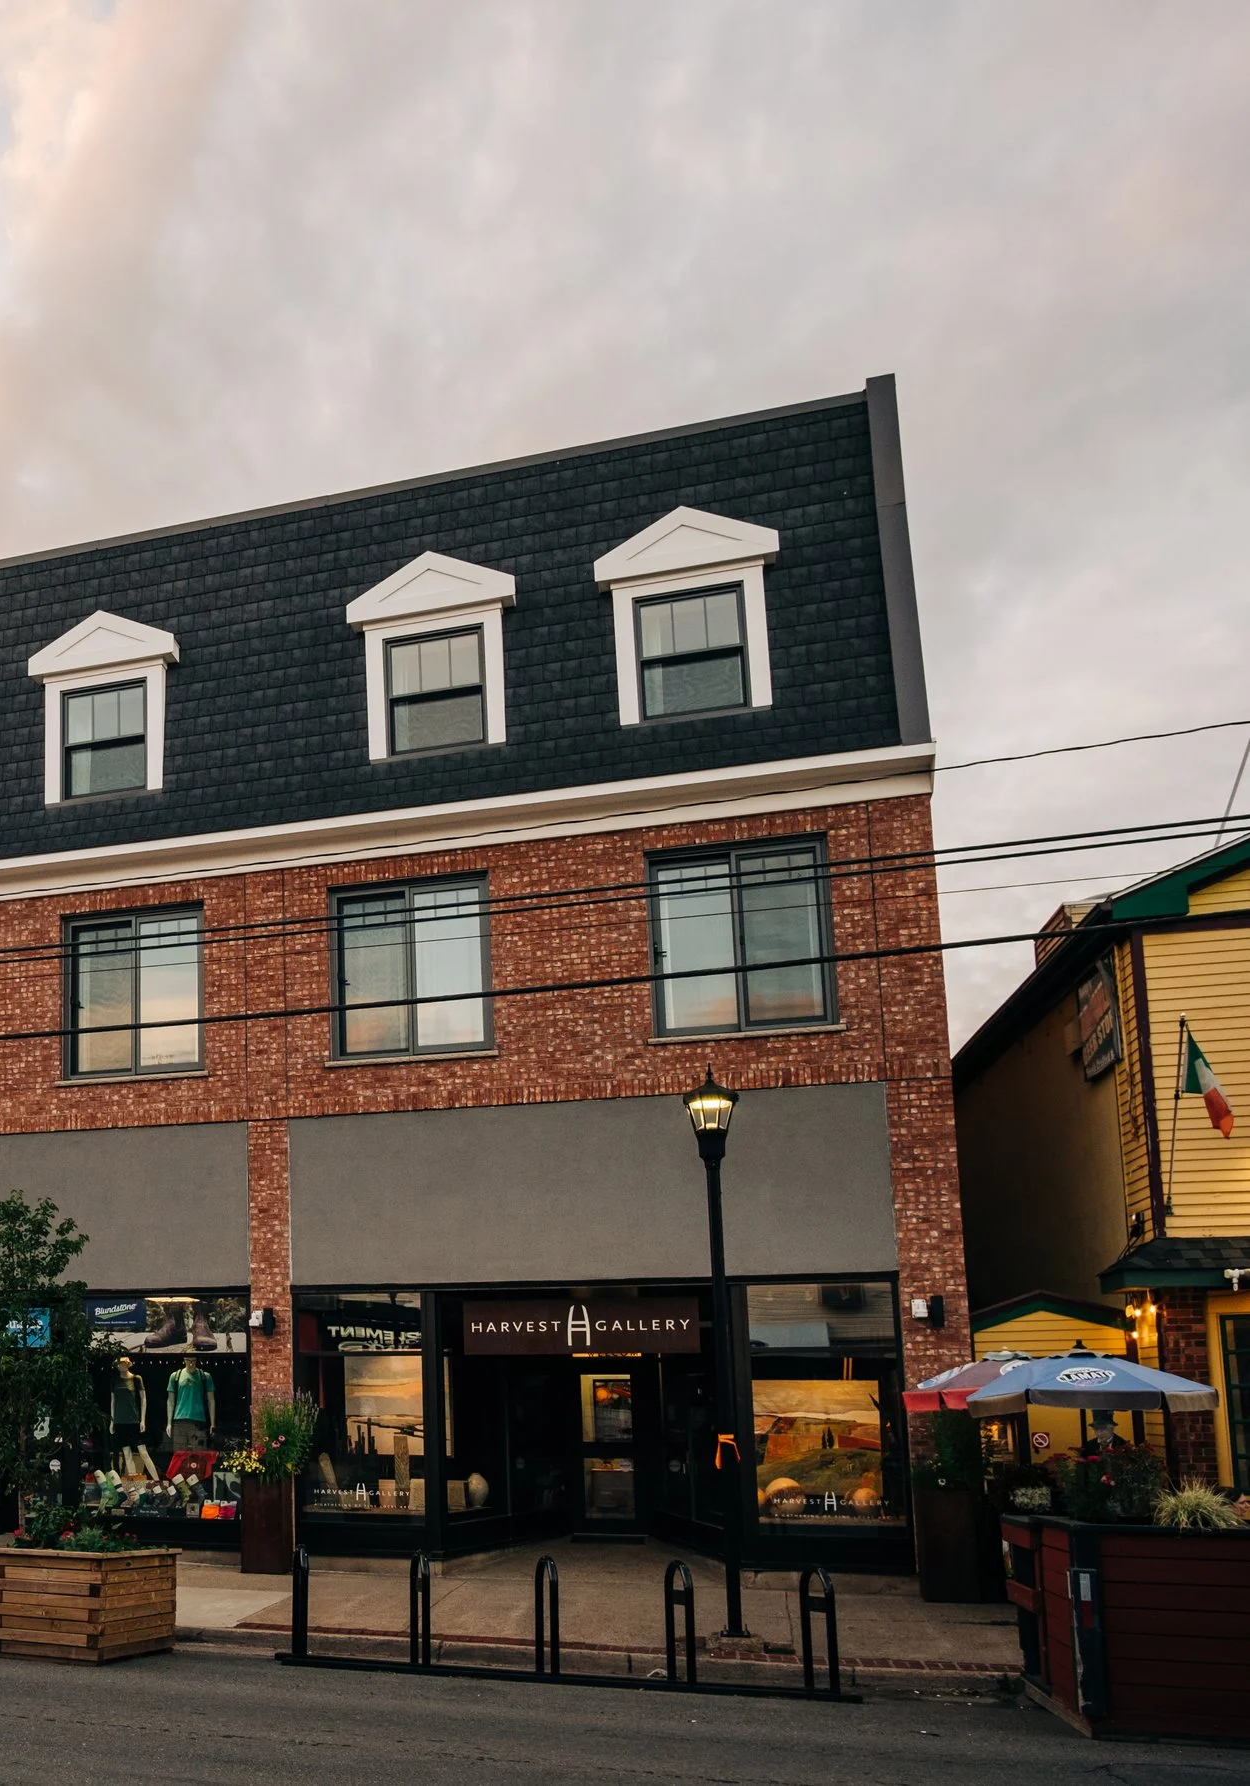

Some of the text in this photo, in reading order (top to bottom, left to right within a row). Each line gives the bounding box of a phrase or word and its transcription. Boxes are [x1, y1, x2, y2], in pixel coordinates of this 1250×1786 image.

[94, 1303, 137, 1316] Blundstone
[471, 1320, 561, 1333] HARVEST
[595, 1319, 690, 1331] GALLERY
